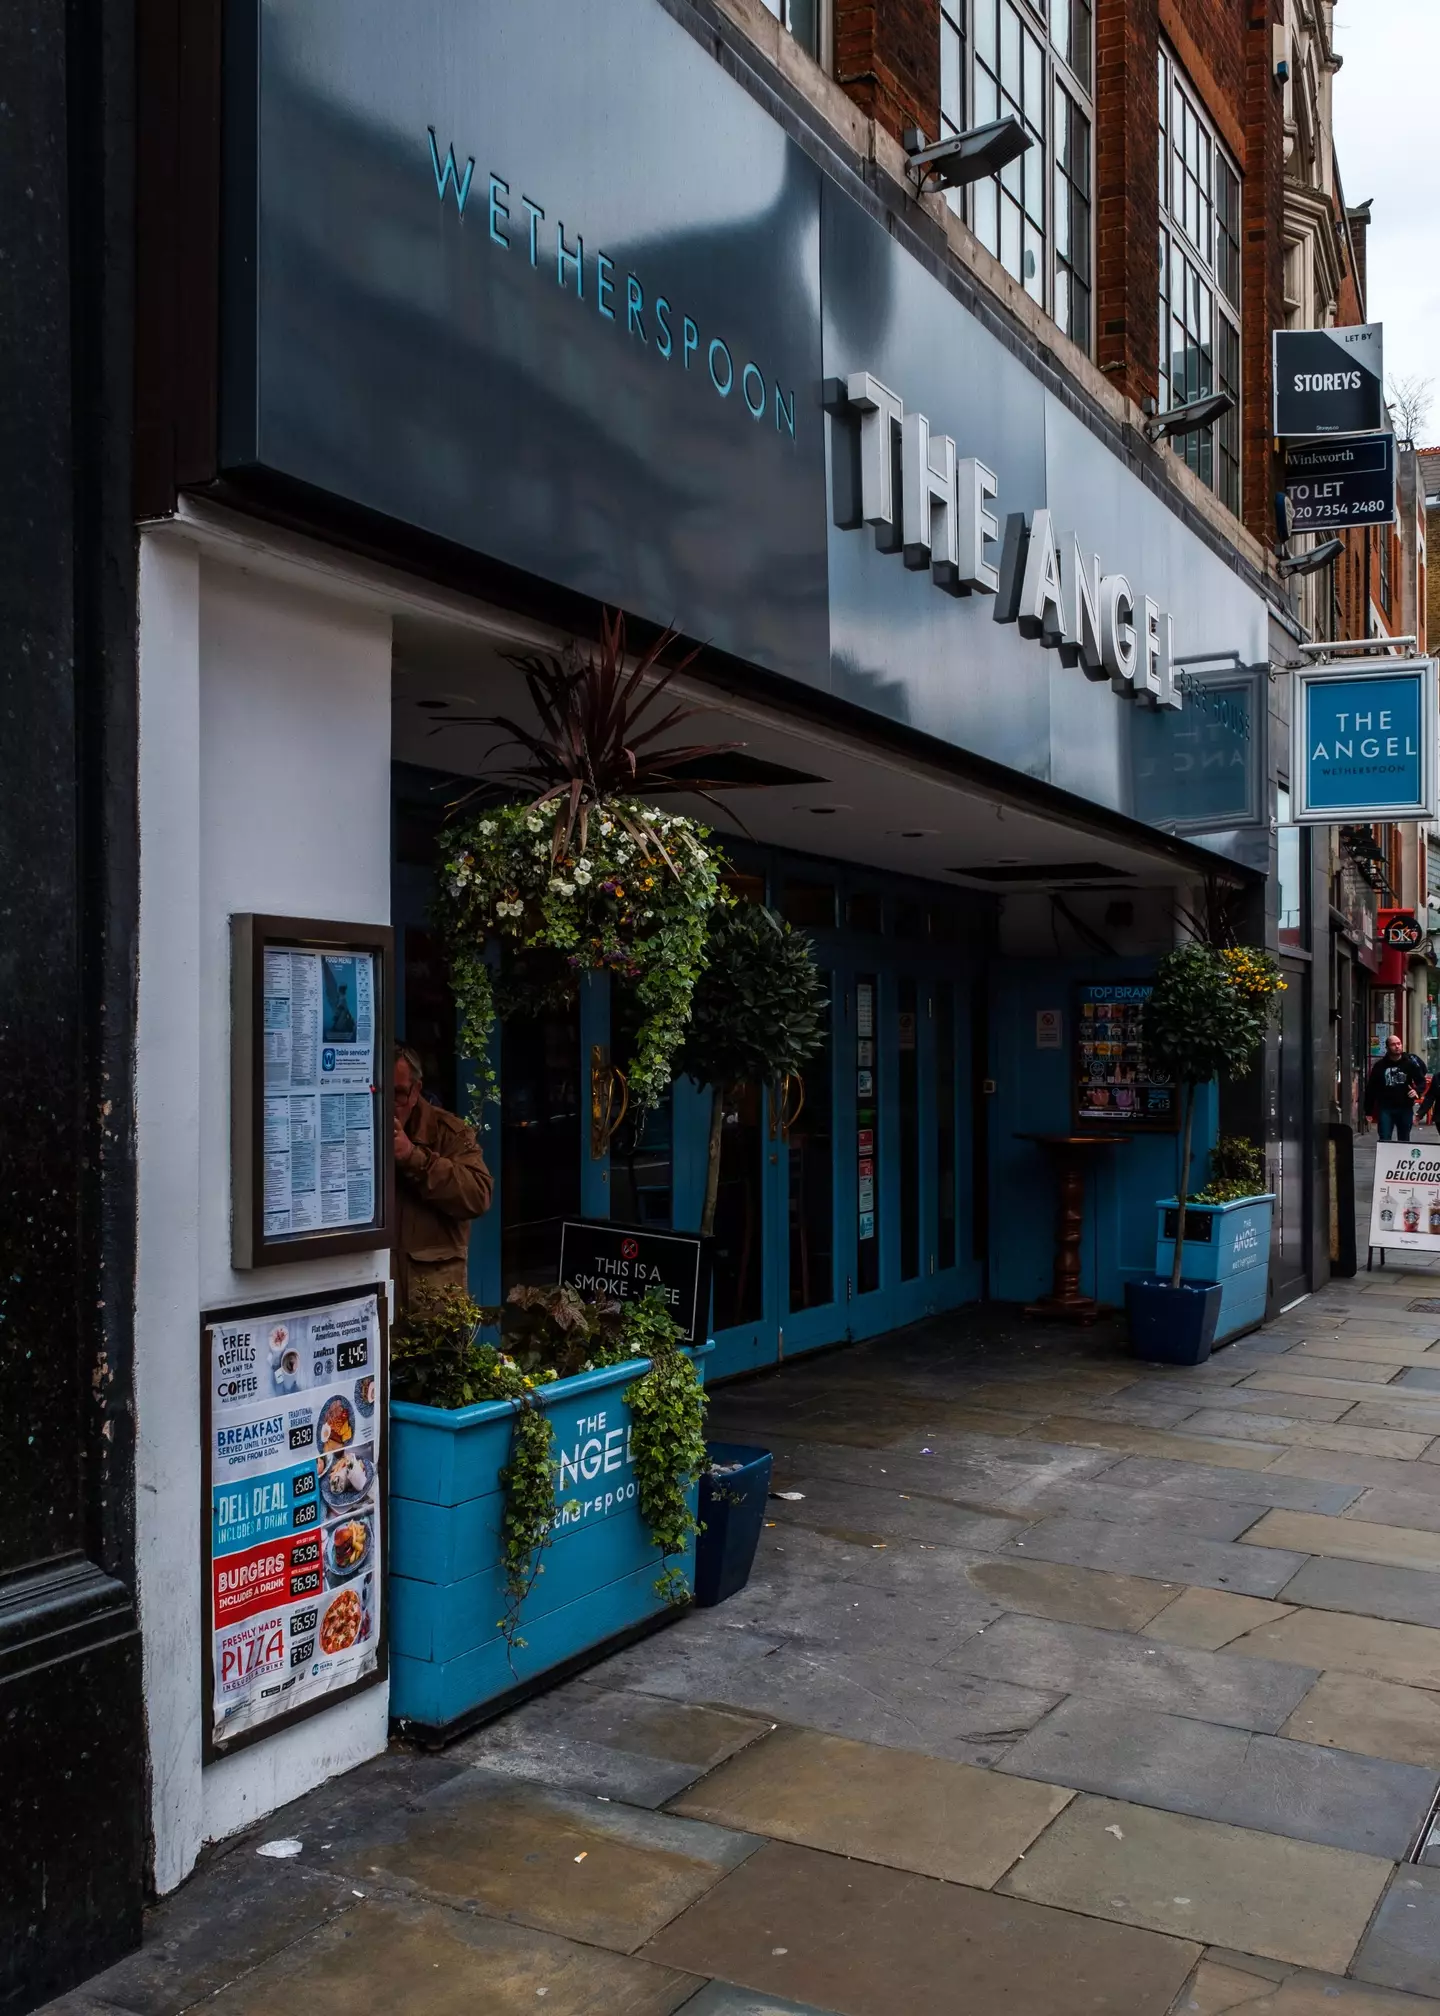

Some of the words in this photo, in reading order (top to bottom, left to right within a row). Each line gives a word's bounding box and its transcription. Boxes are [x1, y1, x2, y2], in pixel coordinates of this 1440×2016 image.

[427, 125, 797, 441] WETHERSPOON
[1345, 334, 1359, 342] LET
[1361, 332, 1372, 340] BY
[1294, 370, 1362, 392] STOREYS
[1288, 449, 1354, 465] Winkworth
[1287, 484, 1310, 500] TO
[1314, 481, 1344, 498] LET
[1315, 503, 1348, 517] 7354
[1352, 499, 1385, 514] 2480
[847, 371, 999, 595] THE
[1018, 507, 1183, 711] ANGEL
[1335, 710, 1392, 732] THE
[1312, 736, 1417, 761] ANGEL
[1322, 764, 1405, 776] WETHERSPOON
[1089, 987, 1112, 998] TOP
[1114, 987, 1154, 998] BRAN
[1396, 1160, 1415, 1171] ICY,
[1233, 1228, 1258, 1252] ANGEL
[594, 1256, 629, 1276] THIS
[634, 1262, 647, 1279] IS
[649, 1265, 661, 1281] A
[574, 1273, 629, 1297] SMOKE
[222, 1333, 251, 1351] FREE
[218, 1348, 256, 1368] REFILLS
[222, 1367, 231, 1375] ON
[232, 1364, 243, 1373] ANY
[217, 1376, 258, 1398] COFFEE
[217, 1417, 283, 1446] BREAKFAST
[576, 1411, 606, 1436] THE
[218, 1445, 243, 1456] SERVED
[244, 1440, 260, 1450] UNTIL
[260, 1438, 267, 1447] 12
[268, 1433, 285, 1444] NOON
[228, 1454, 246, 1465] OPEN
[247, 1449, 263, 1461] FROM
[559, 1425, 638, 1491] NGEL
[253, 1482, 288, 1517] DEAL
[295, 1504, 316, 1524] £6.89
[218, 1522, 255, 1544] INCLUDES
[256, 1518, 262, 1532] A
[293, 1544, 318, 1563] £5.99
[218, 1553, 285, 1592] BURGERS
[293, 1573, 318, 1592] £6.99
[219, 1588, 253, 1609] INCLUDES
[254, 1586, 260, 1595] A
[260, 1578, 284, 1593] DRINK
[293, 1612, 316, 1632] £6.59
[222, 1627, 256, 1650] FRESHLY
[258, 1618, 283, 1633] MADE
[221, 1629, 284, 1682] PIZZA
[261, 1662, 283, 1673] DRINK
